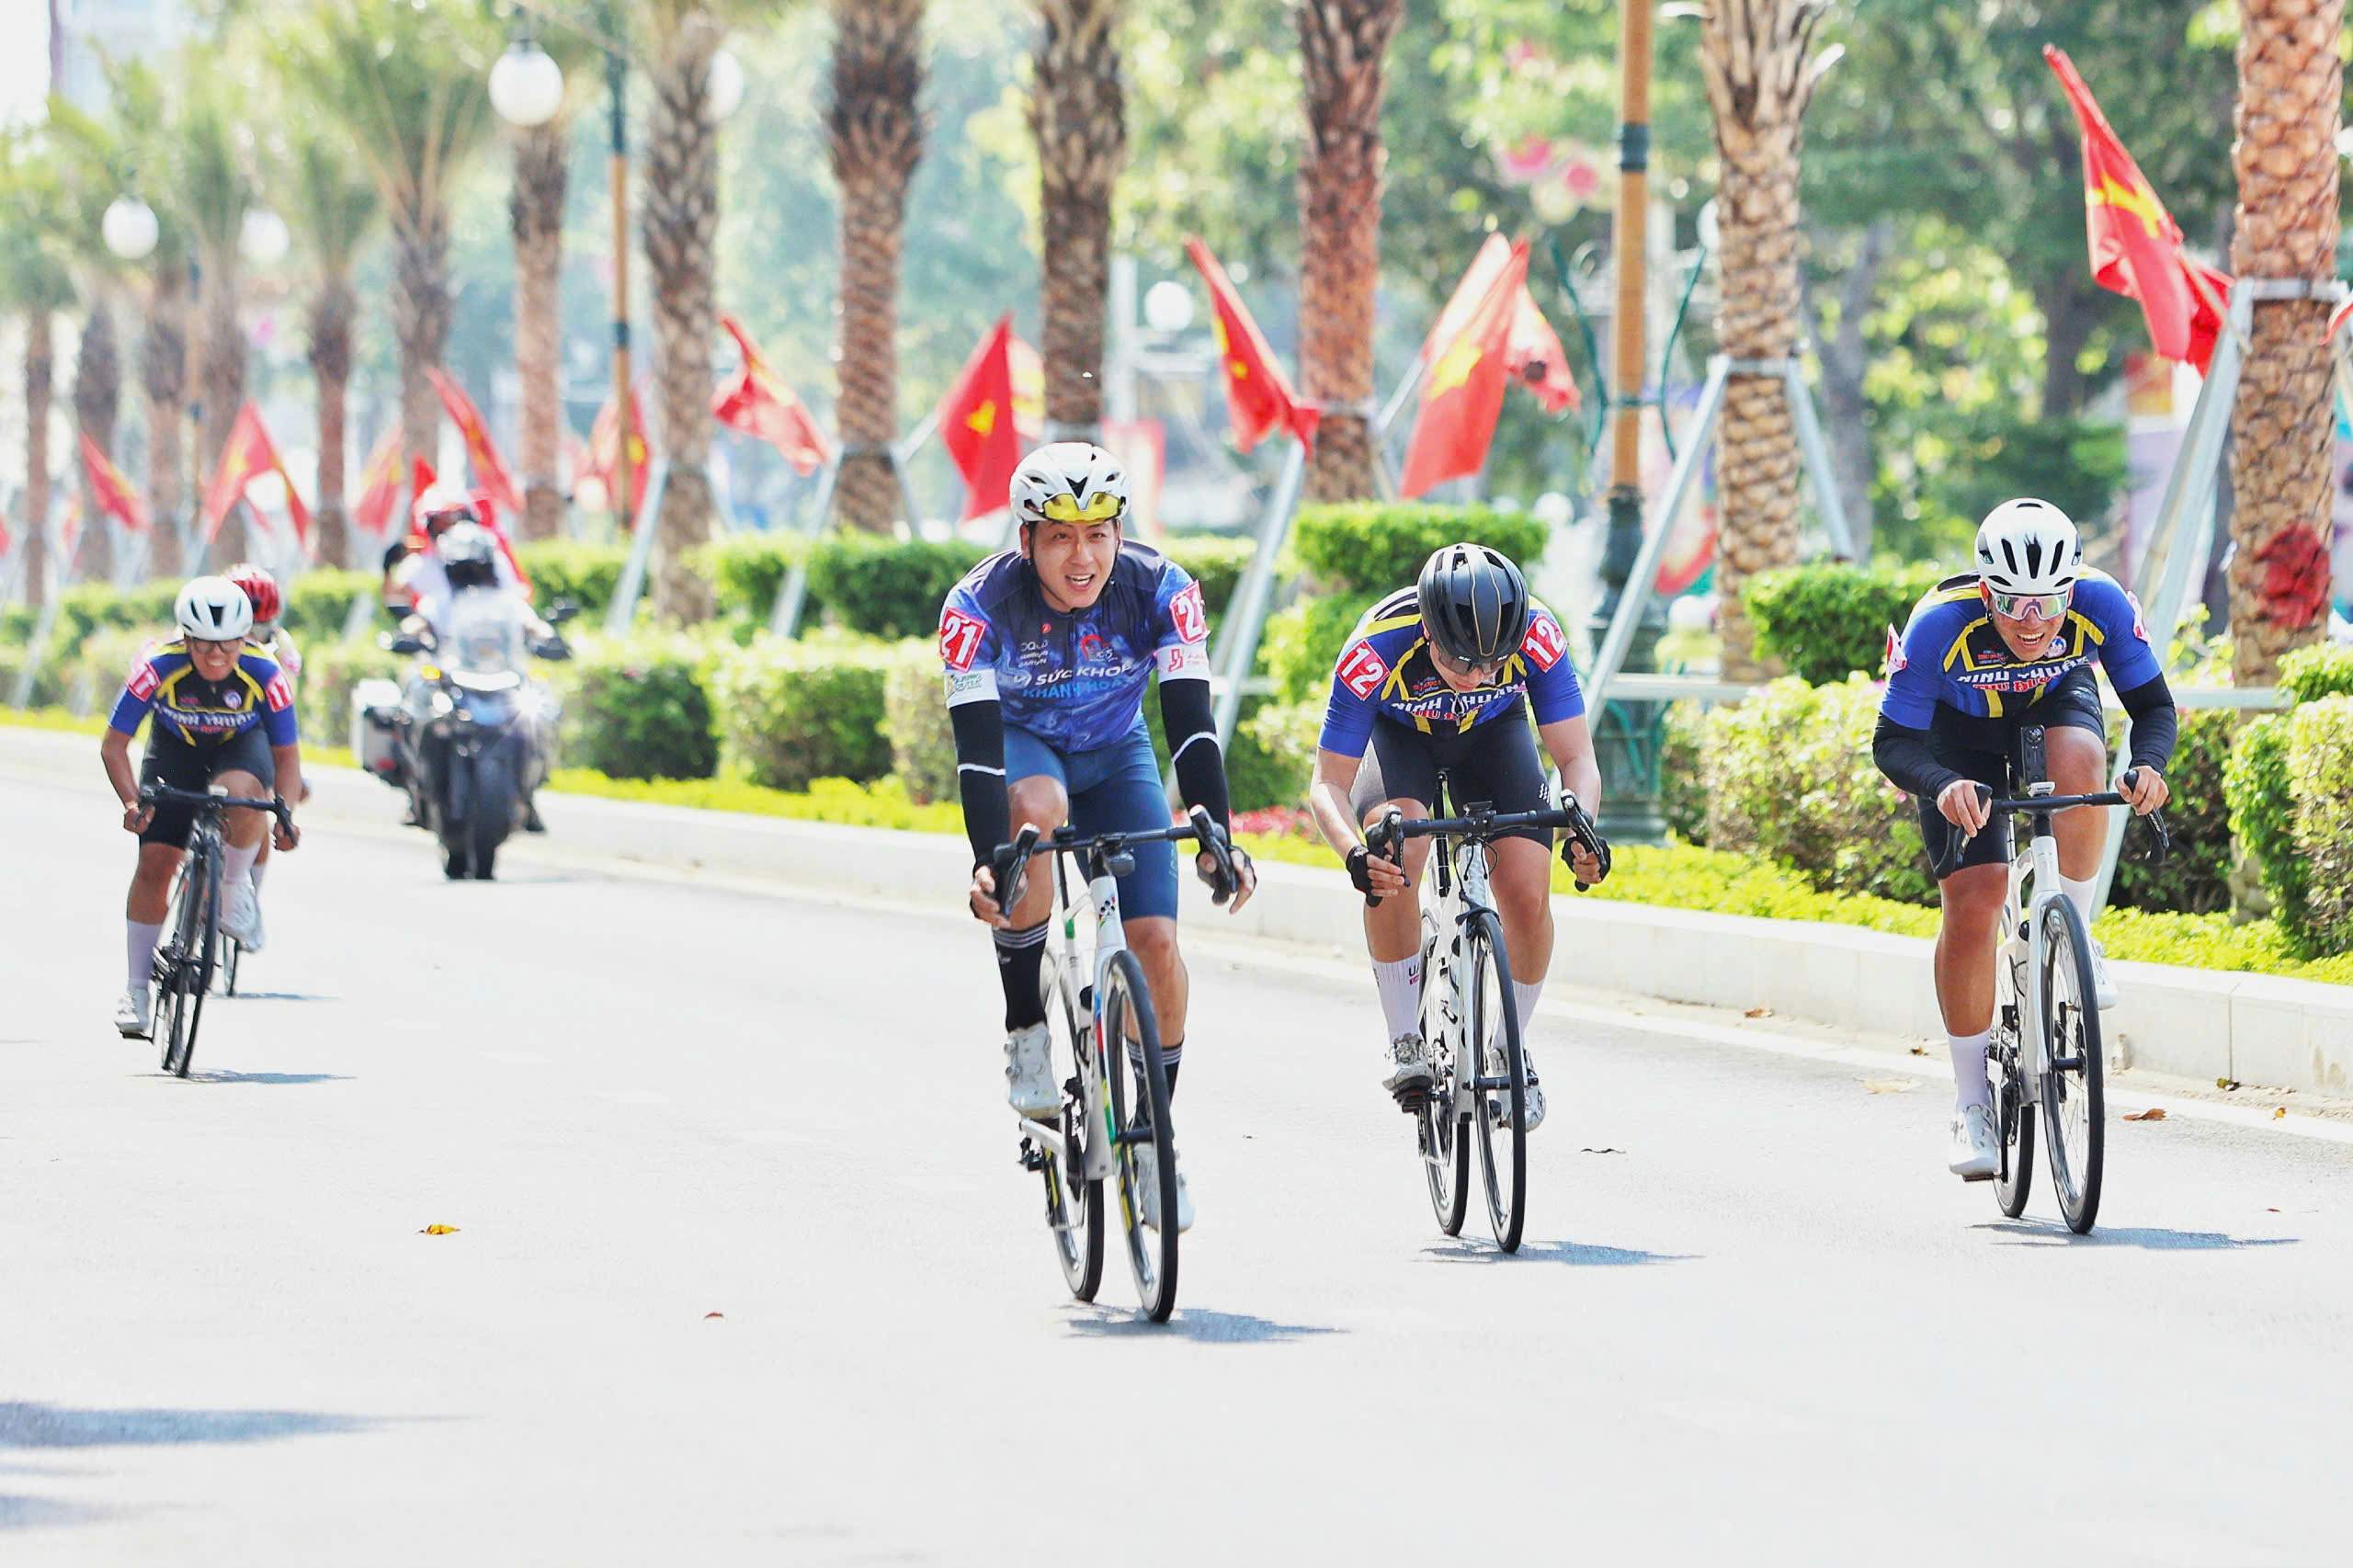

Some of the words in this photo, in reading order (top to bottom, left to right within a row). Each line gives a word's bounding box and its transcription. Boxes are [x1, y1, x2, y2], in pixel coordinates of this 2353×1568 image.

[942, 617, 978, 665] 21
[1526, 619, 1565, 664] 12
[1342, 647, 1383, 695] 12
